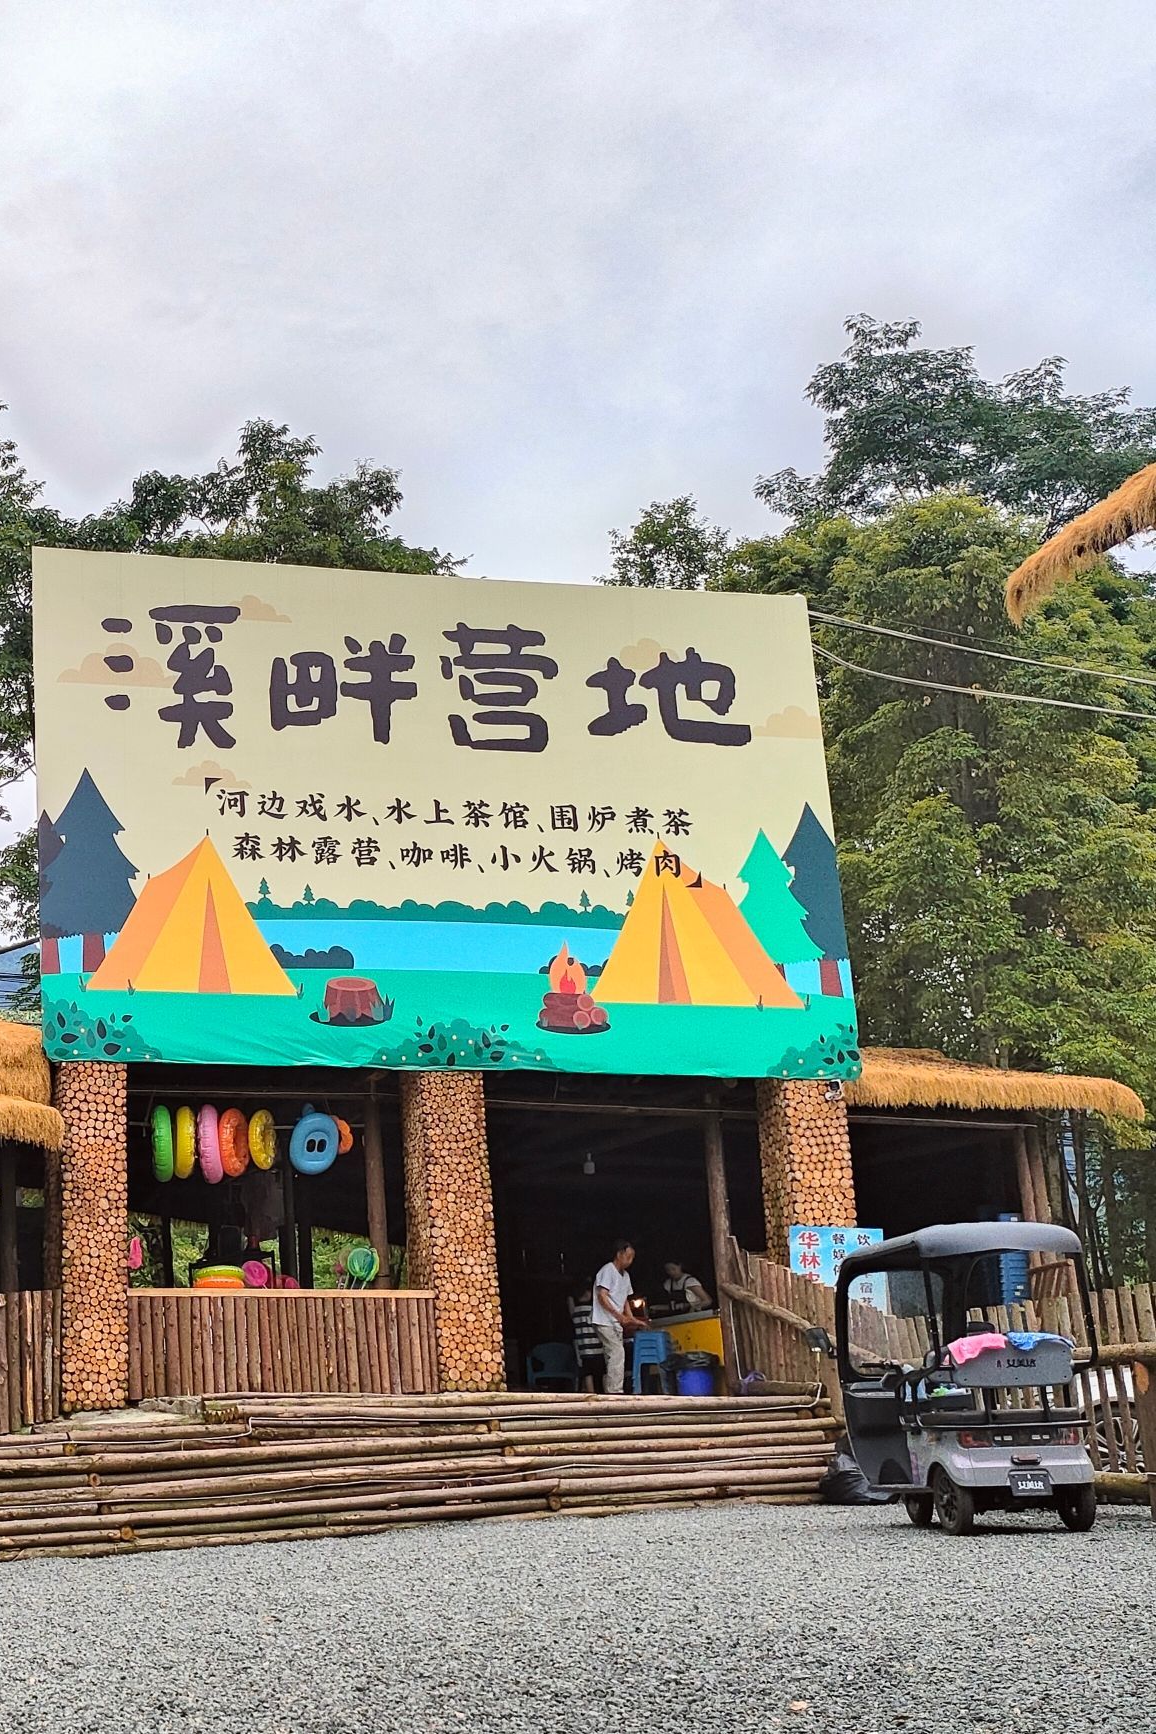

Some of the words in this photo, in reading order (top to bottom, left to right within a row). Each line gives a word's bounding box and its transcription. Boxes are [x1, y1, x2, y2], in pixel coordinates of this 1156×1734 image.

[100, 604, 752, 753] 溪畔营地
[215, 788, 694, 836] 河边戏水、水上茶馆、围炉煮茶
[231, 832, 681, 878] 森林露营、咖啡、小火锅、烤肉
